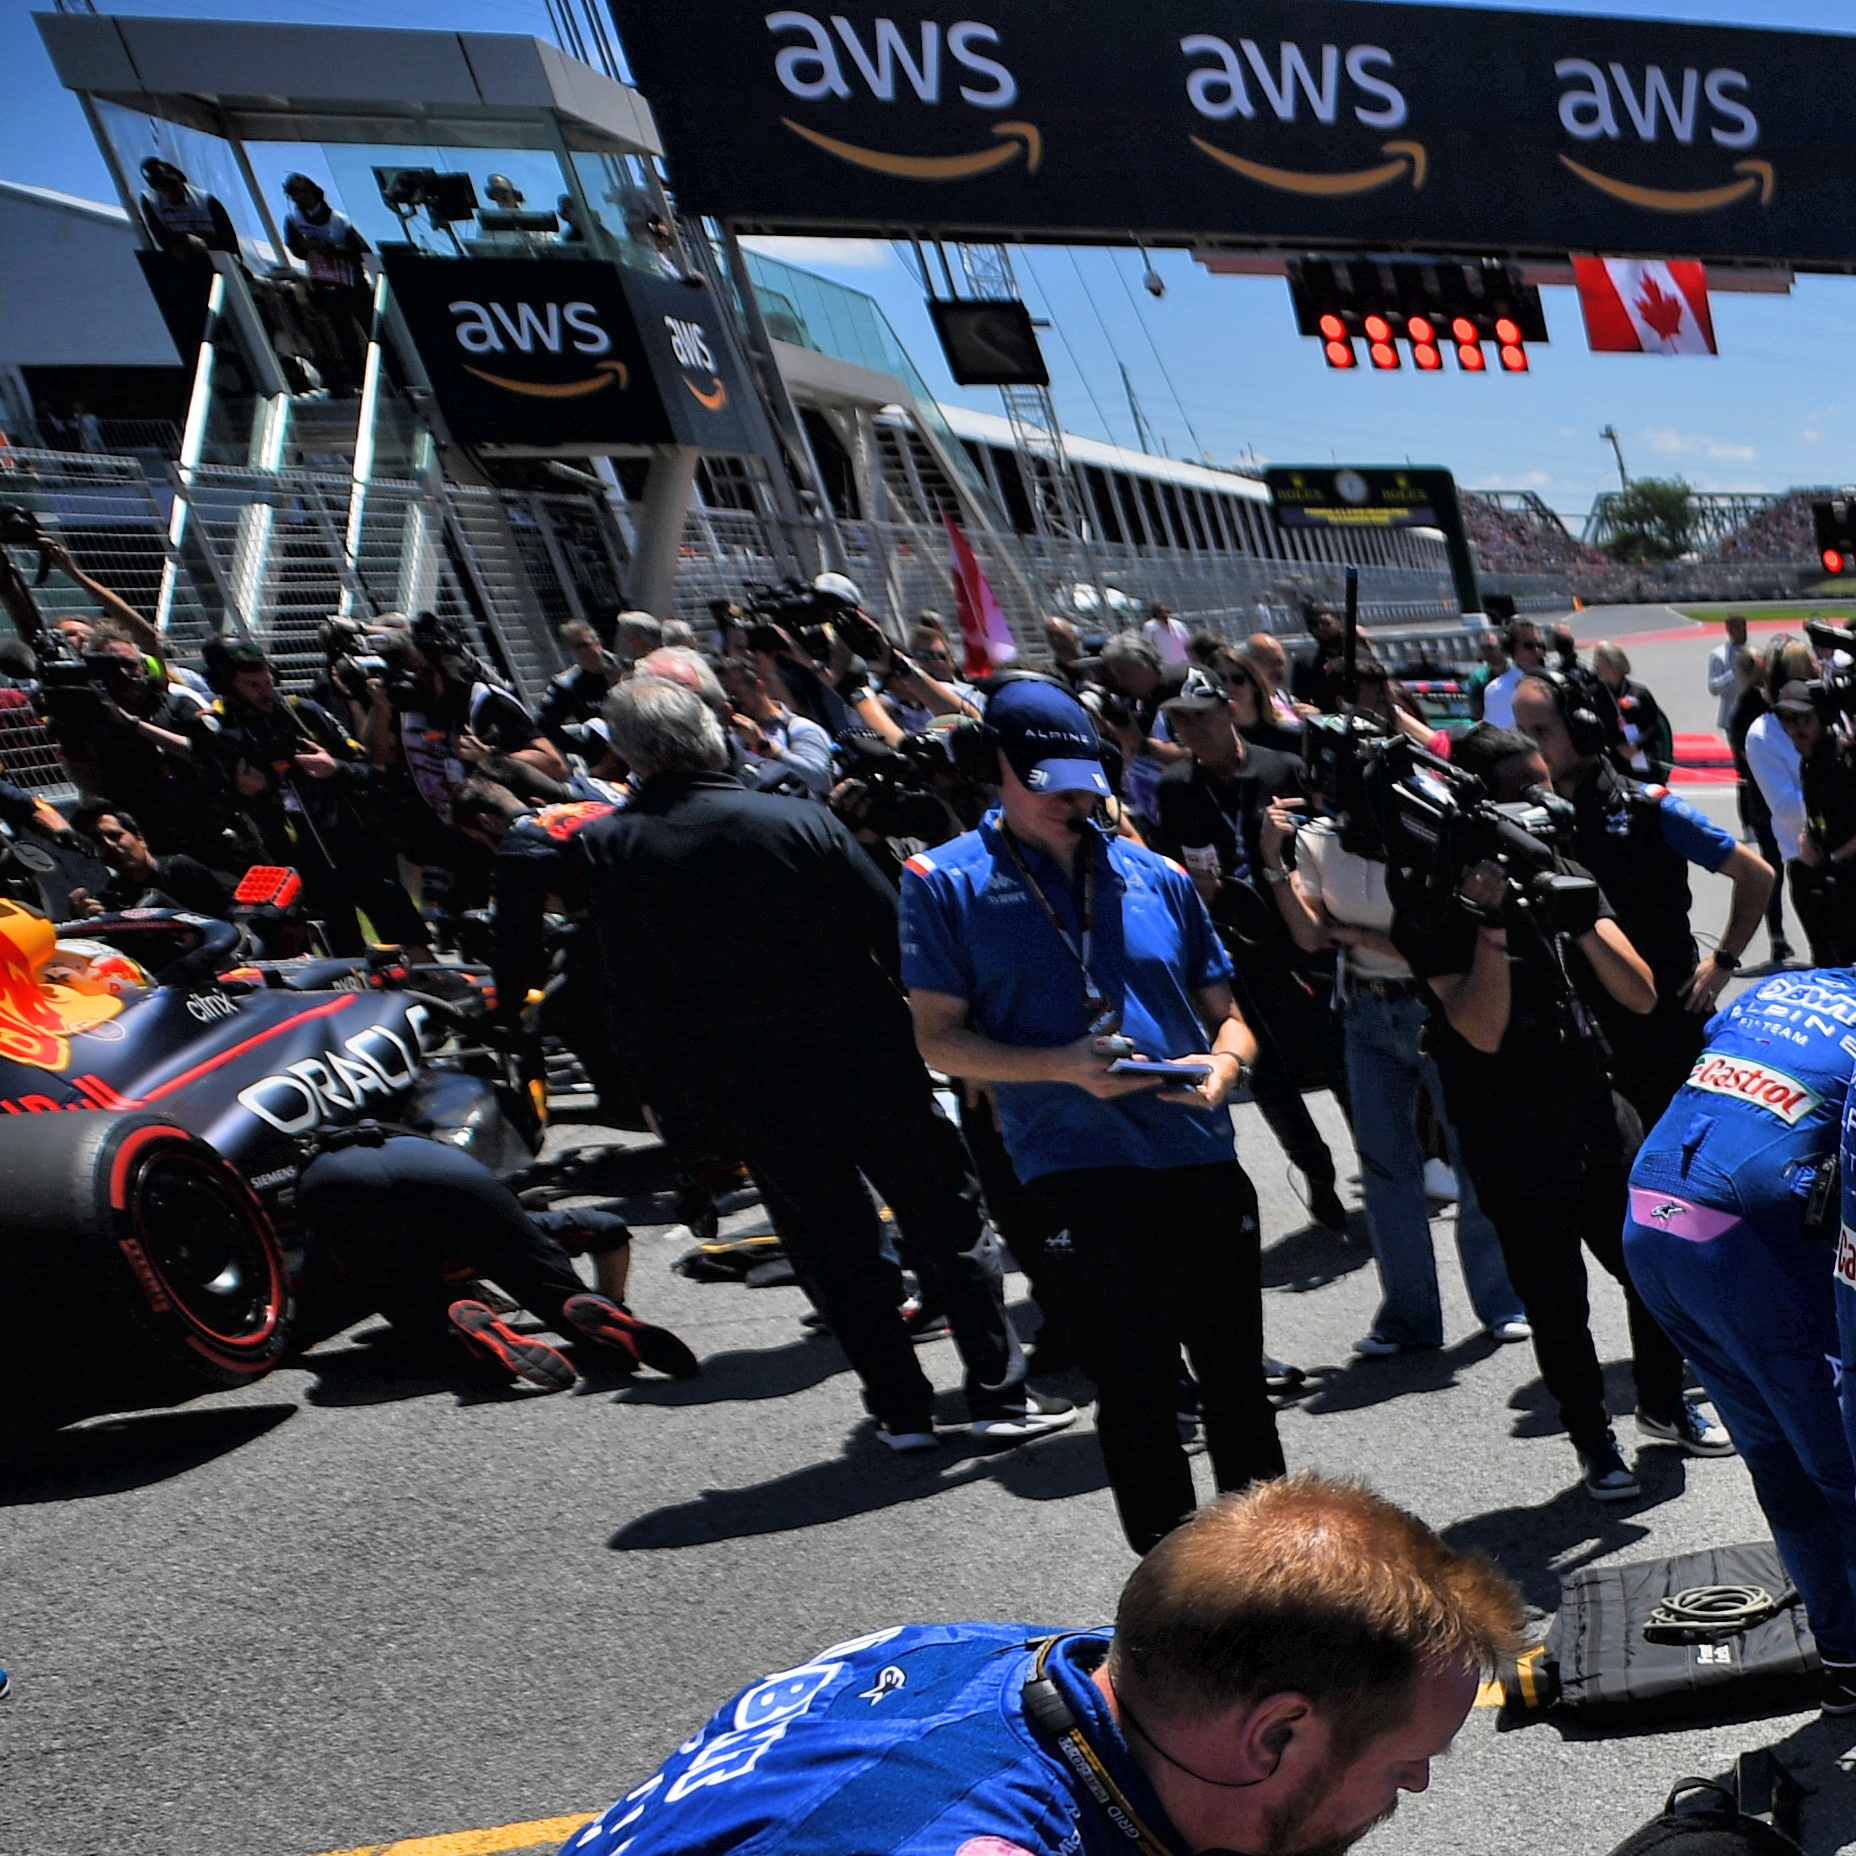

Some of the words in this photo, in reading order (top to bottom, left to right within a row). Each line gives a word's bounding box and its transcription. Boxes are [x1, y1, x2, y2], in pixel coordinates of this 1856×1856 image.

[765, 9, 1019, 108] aws
[1180, 33, 1408, 129] aws
[1553, 57, 1760, 149] aws
[449, 300, 613, 354] aws
[664, 314, 717, 373] aws
[1025, 728, 1088, 744] ALPINE
[1028, 768, 1048, 785] 31
[187, 988, 240, 1024] citrix
[1763, 1021, 1810, 1047] TEAM
[1699, 1058, 1807, 1116] Castrol
[250, 1165, 297, 1191] SIEMENS
